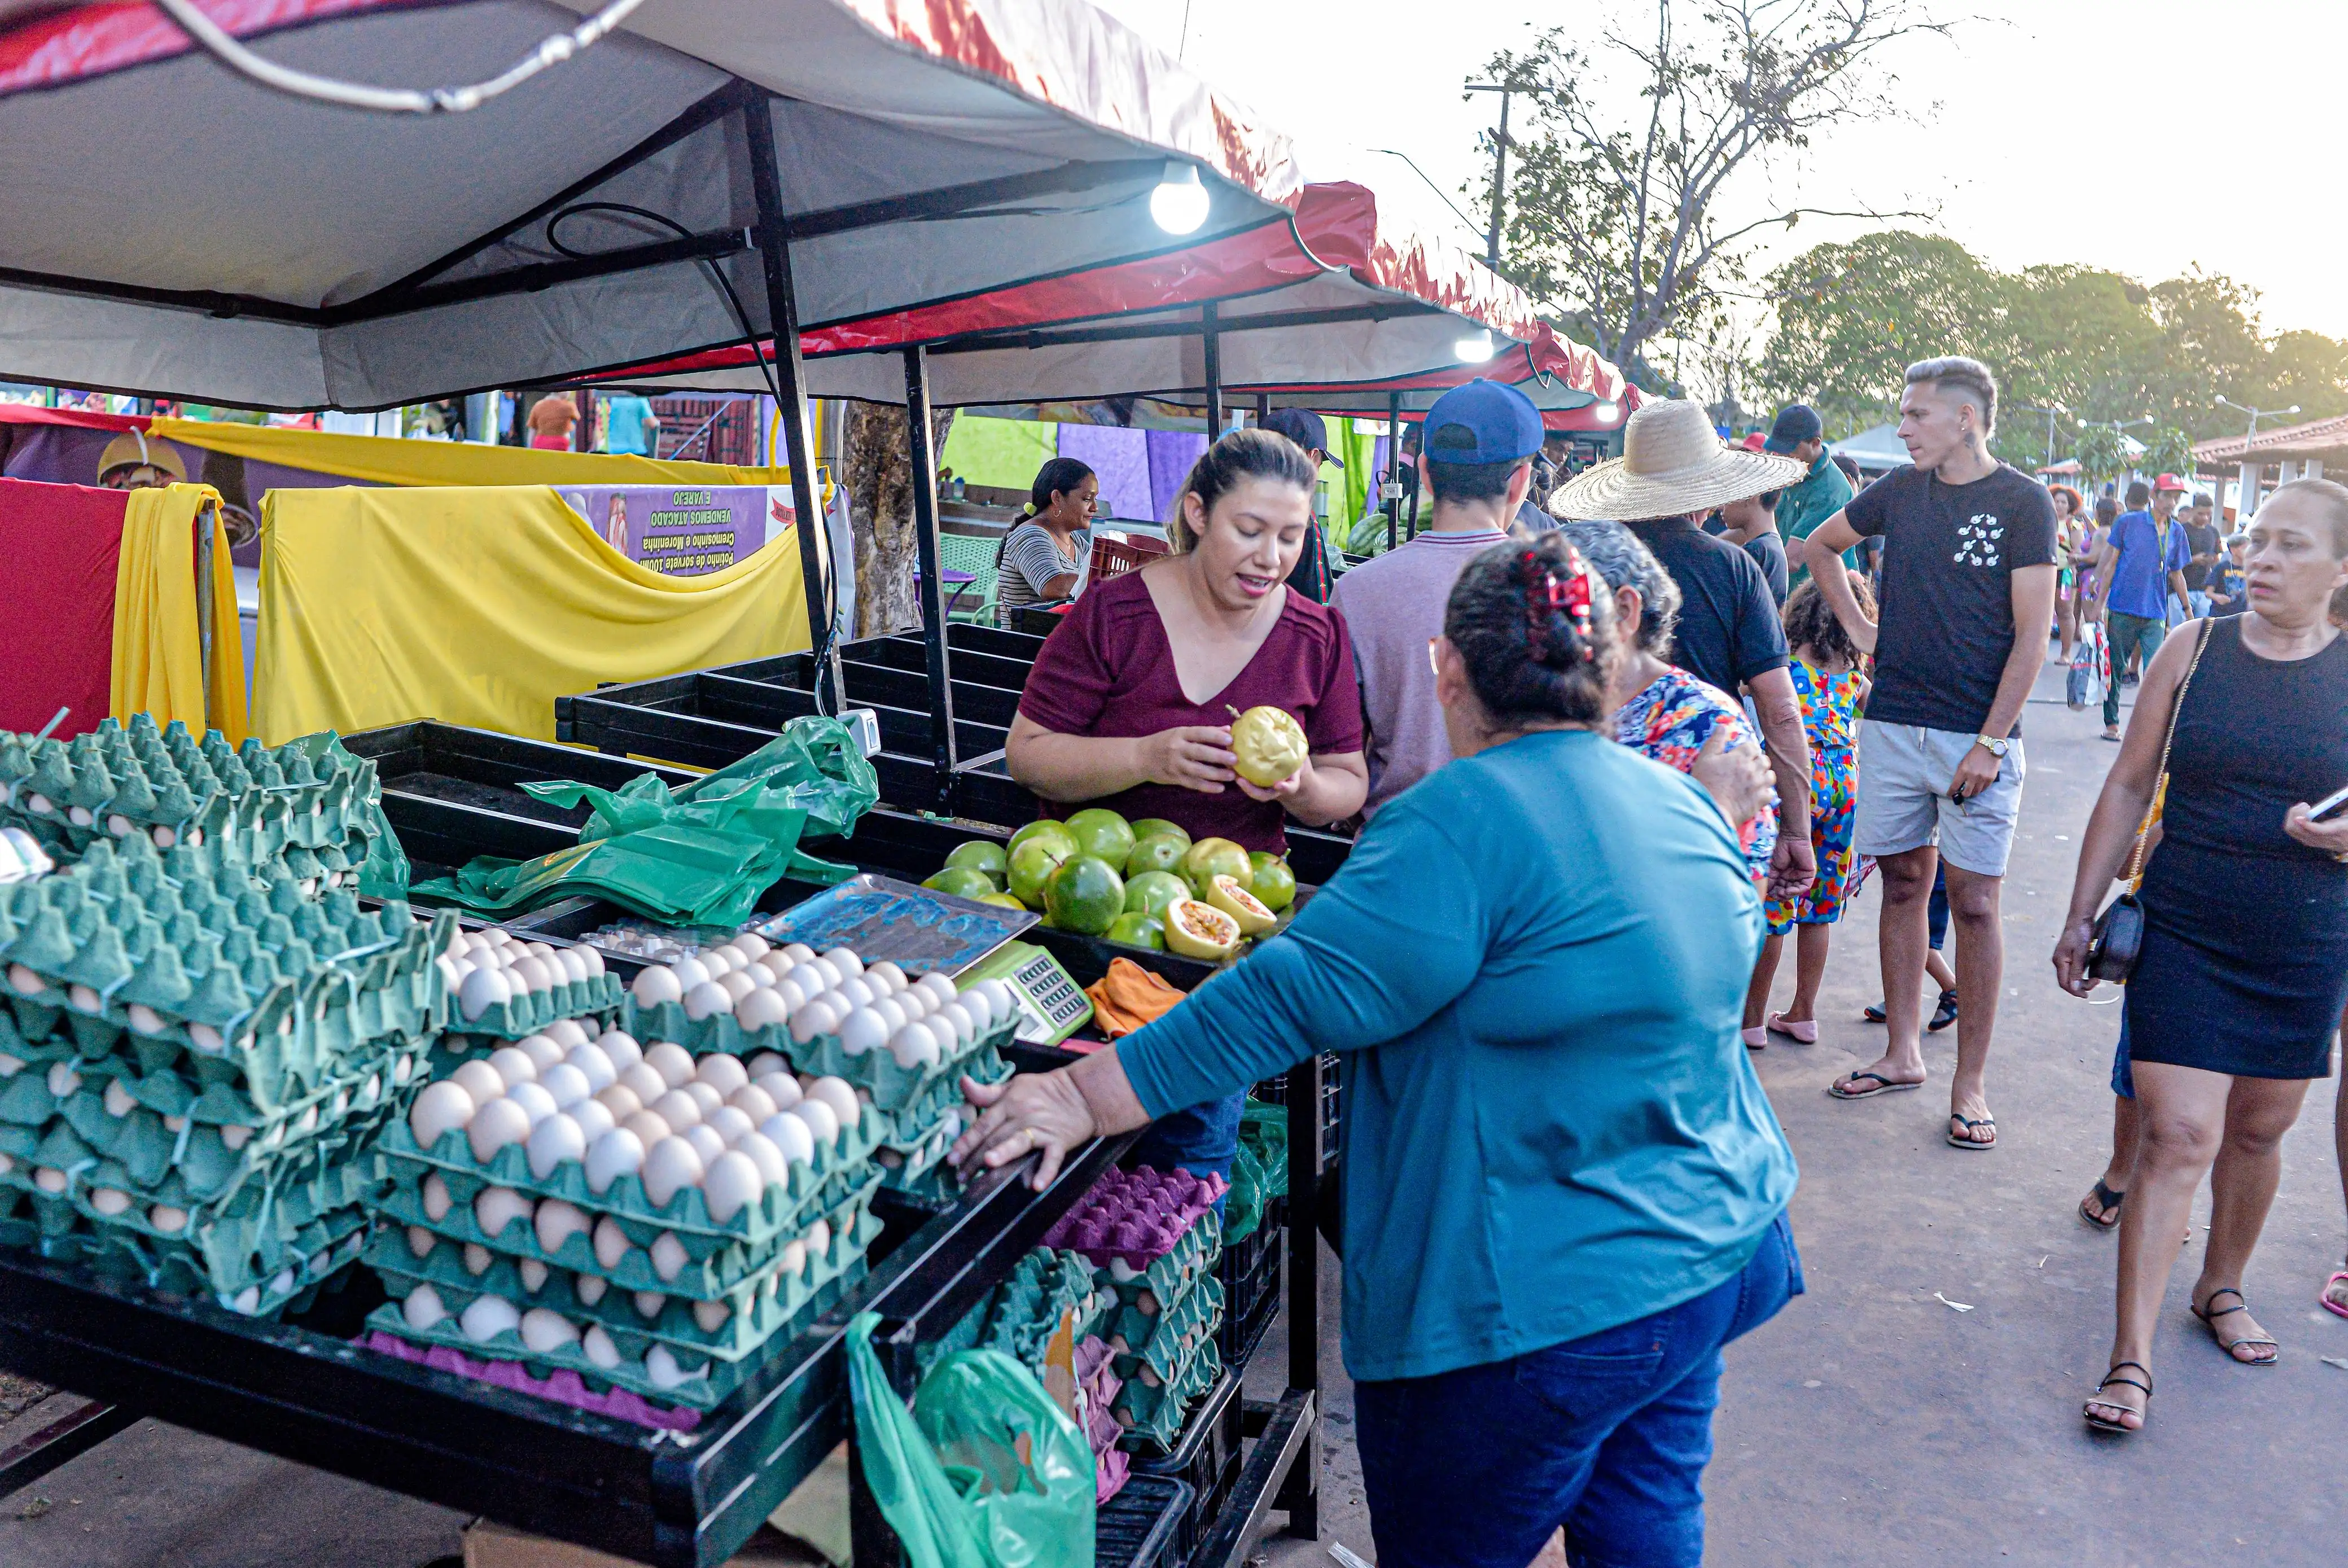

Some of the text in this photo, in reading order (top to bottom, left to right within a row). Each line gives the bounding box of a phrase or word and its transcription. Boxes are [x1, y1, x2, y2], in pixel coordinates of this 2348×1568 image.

[673, 491, 711, 506] E VAREJO
[651, 509, 731, 528] VENDEMOS ATACADO
[643, 532, 734, 553] Cremosinho e Moreninha
[665, 556, 694, 572] sorvete
[696, 555, 706, 570] de
[707, 552, 734, 568] Potinho
